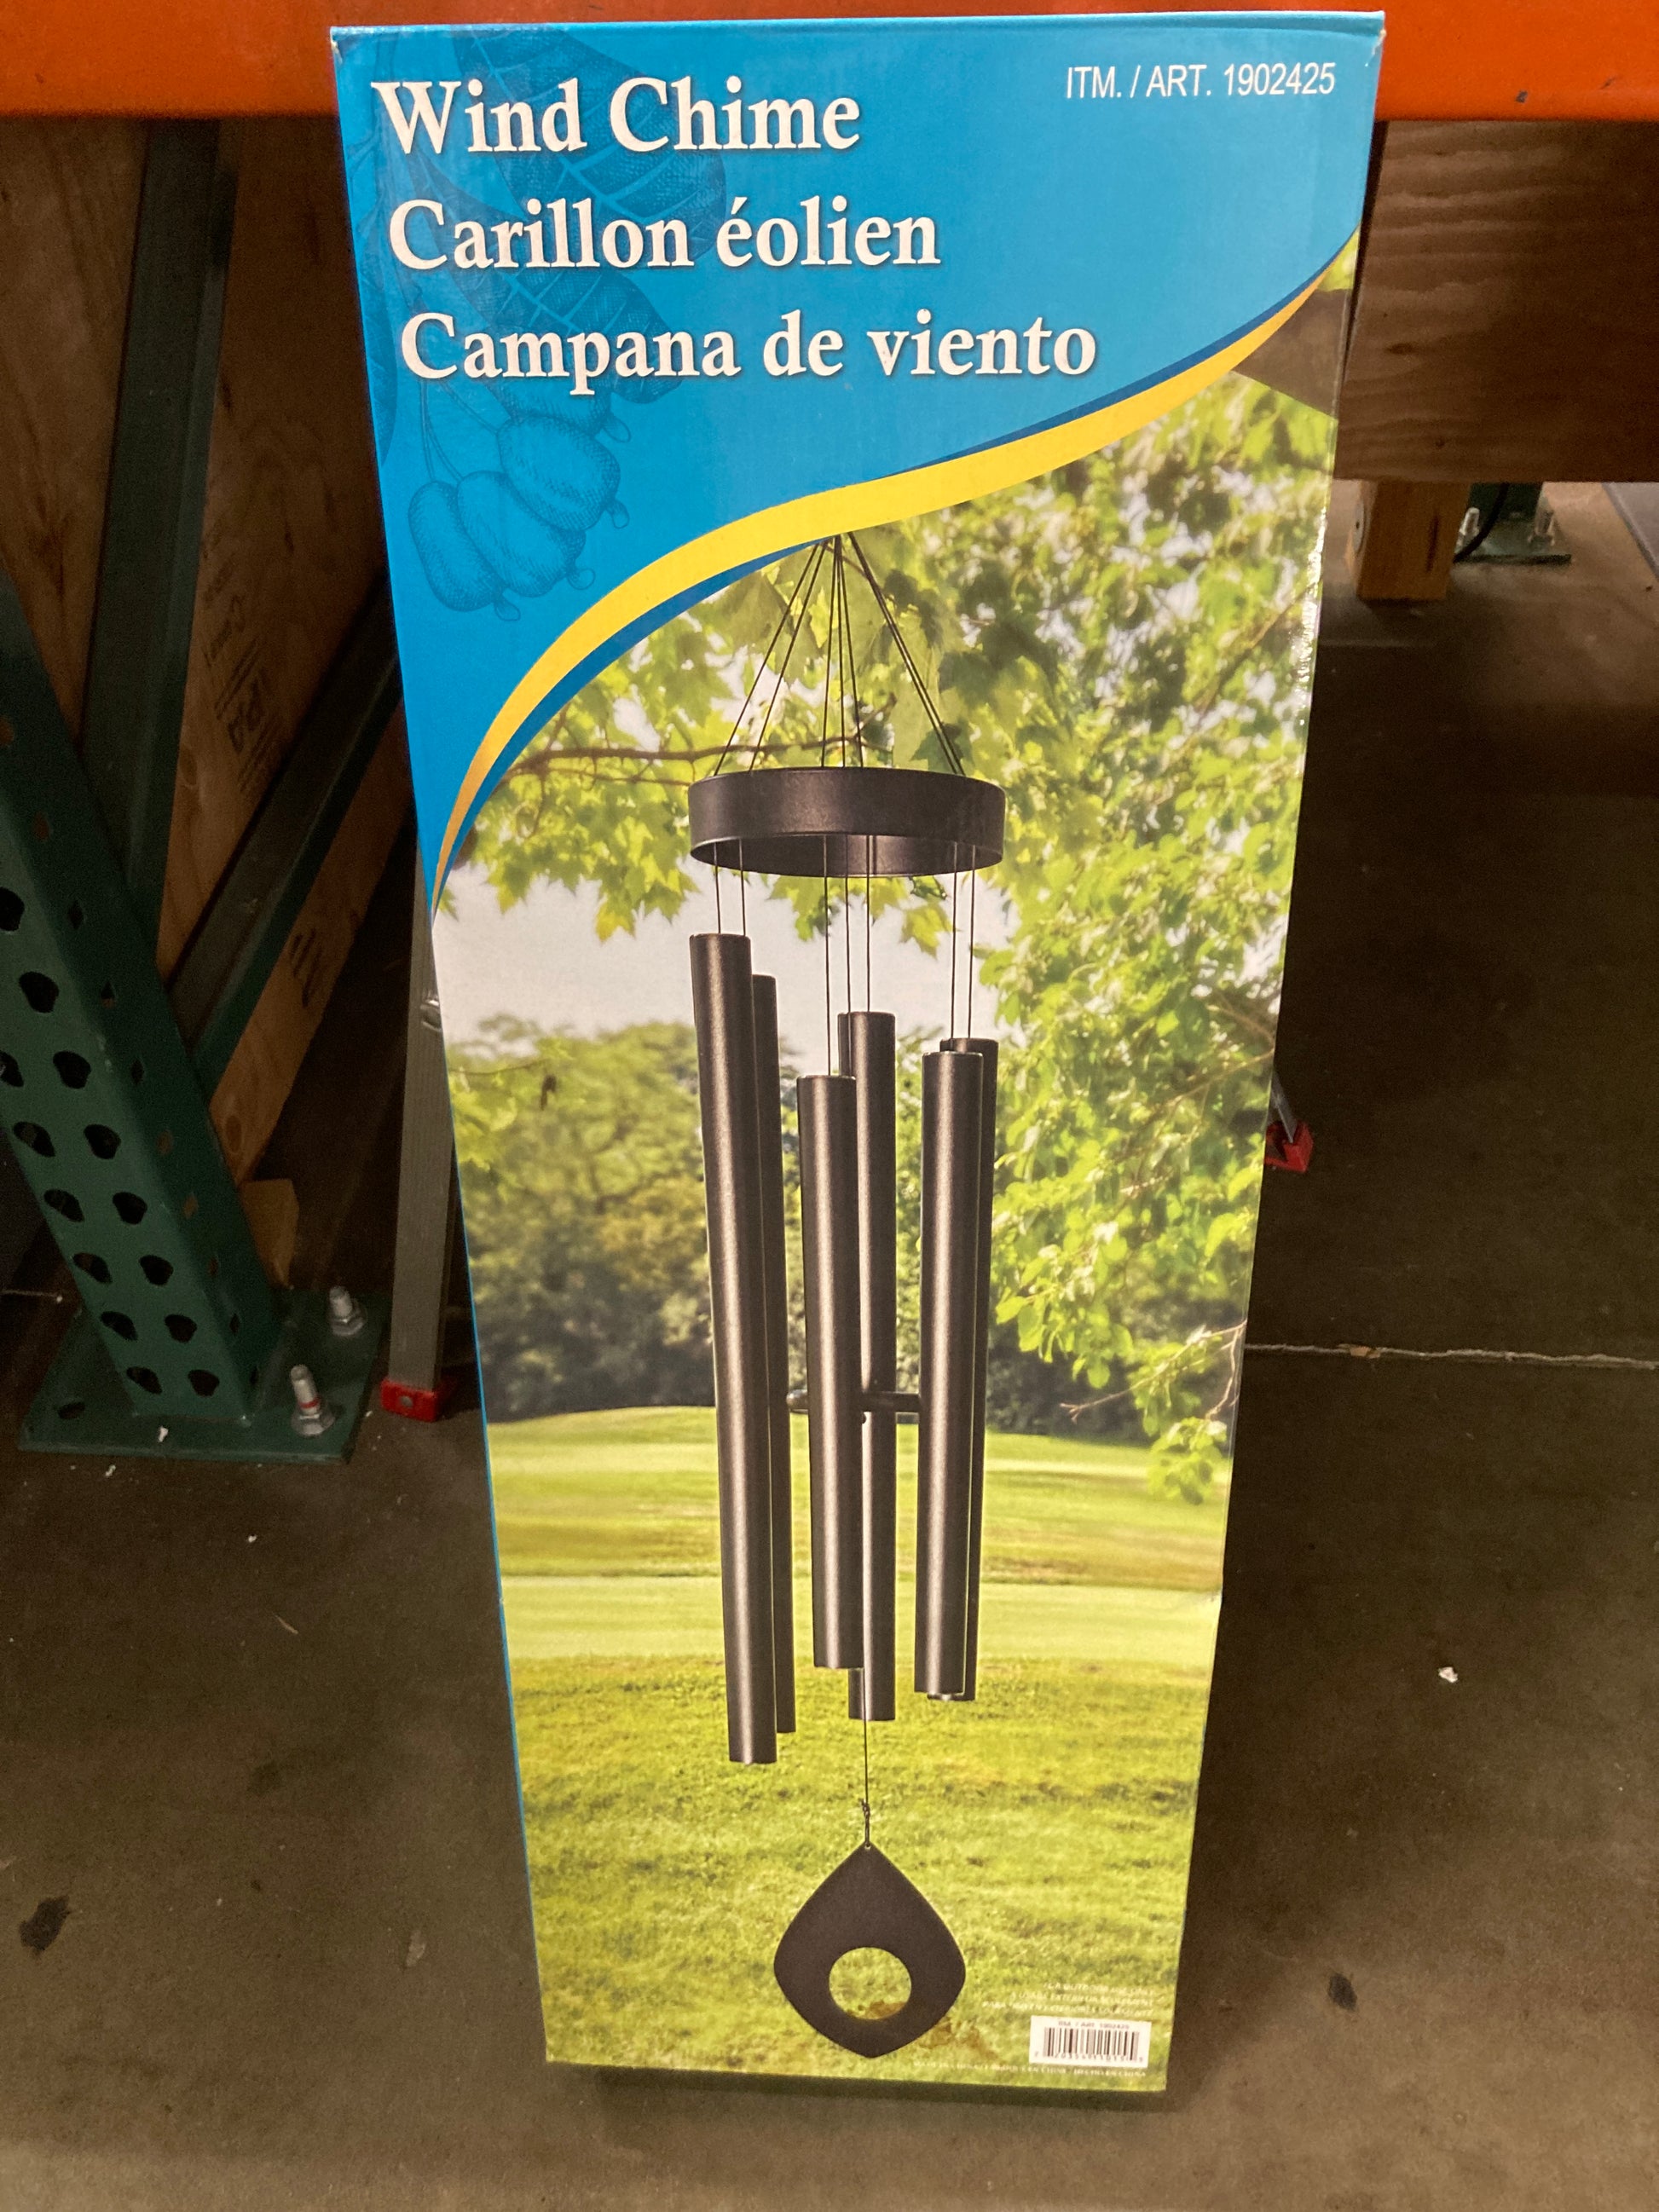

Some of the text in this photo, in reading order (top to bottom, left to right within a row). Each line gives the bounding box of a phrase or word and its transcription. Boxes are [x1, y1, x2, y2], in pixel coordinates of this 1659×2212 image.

[371, 76, 860, 154] Wind Chime
[1066, 62, 1337, 99] ITM. / ART. 1902425
[389, 196, 941, 270] Carillon éolien
[401, 309, 1096, 396] Campana de viento
